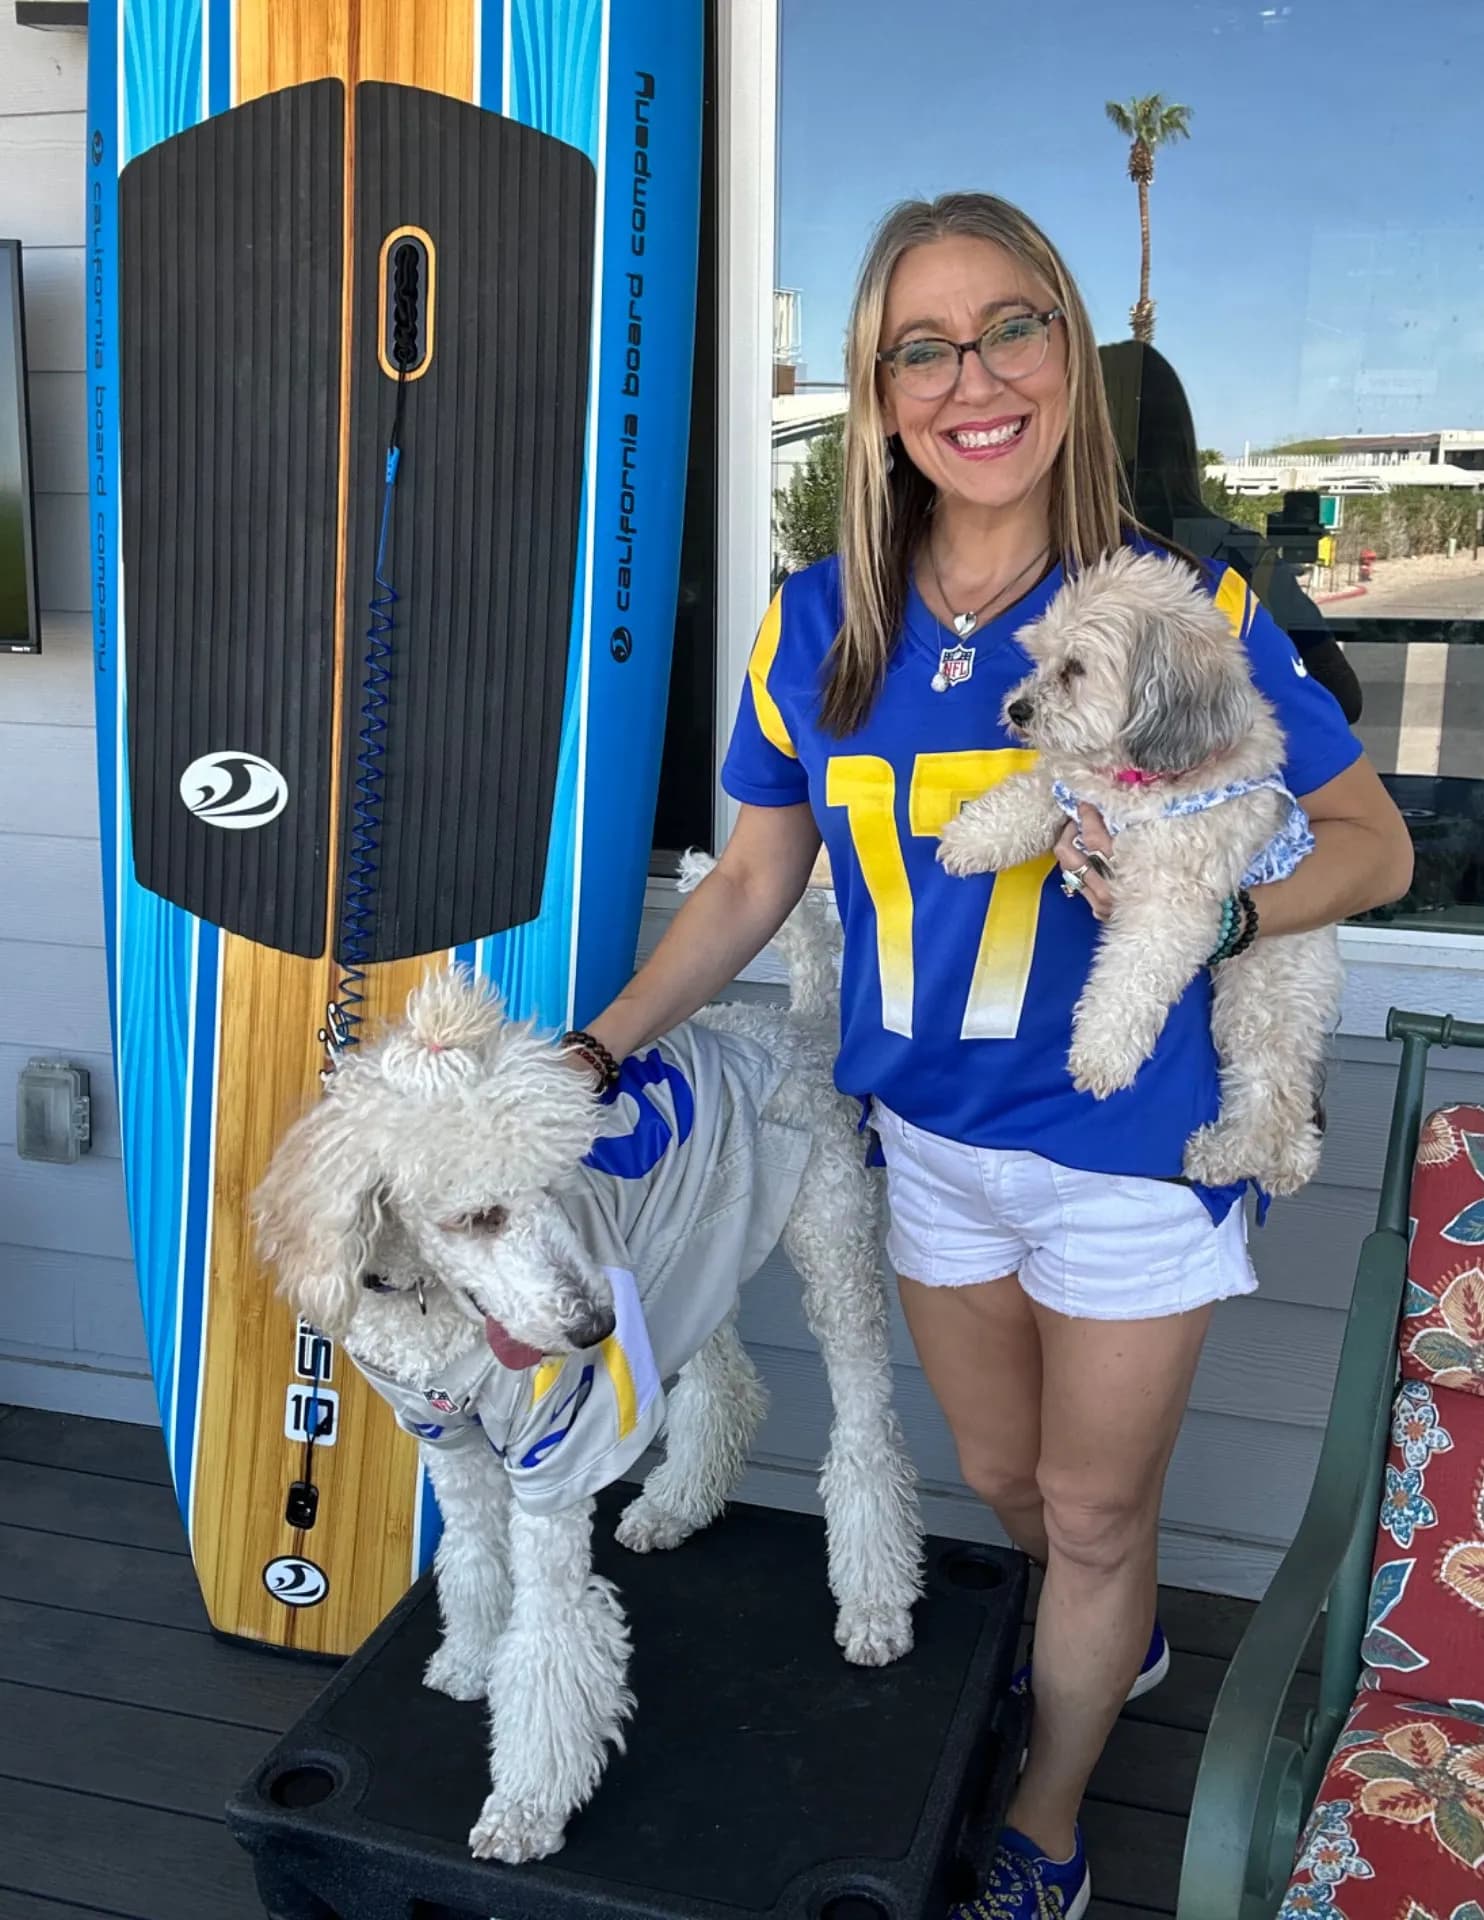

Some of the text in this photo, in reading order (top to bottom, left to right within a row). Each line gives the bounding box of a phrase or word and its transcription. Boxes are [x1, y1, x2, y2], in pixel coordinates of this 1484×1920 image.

[95, 385, 108, 497] board
[615, 71, 656, 613] california board company
[944, 661, 969, 678] NFL
[826, 747, 1059, 1040] 17
